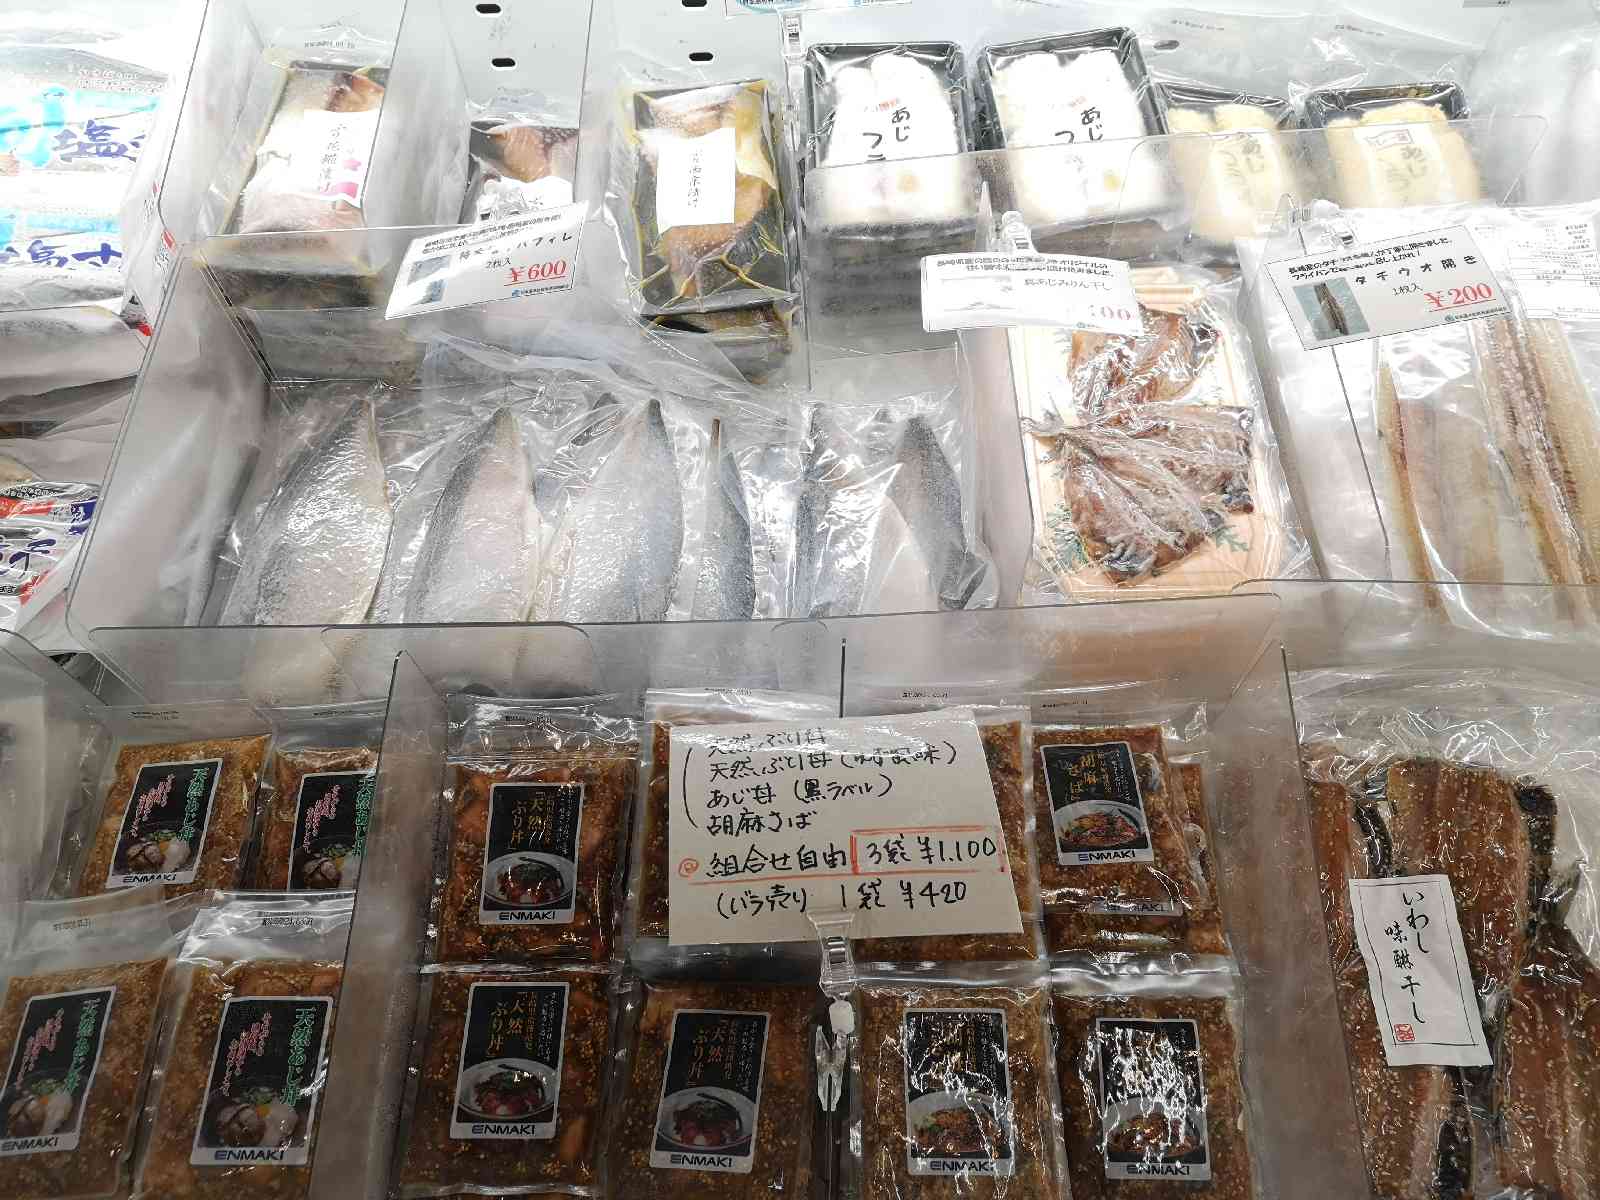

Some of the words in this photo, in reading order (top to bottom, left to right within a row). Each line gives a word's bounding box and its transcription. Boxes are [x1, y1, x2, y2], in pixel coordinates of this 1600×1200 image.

[509, 260, 567, 282] ¥600
[1355, 254, 1478, 285] タチウオ開き
[1423, 282, 1493, 308] ¥200
[707, 783, 776, 808] あじ丼
[706, 807, 817, 837] 胡麻さば
[706, 843, 847, 878] 組合せ自由
[1078, 850, 1136, 862] ENMAKI
[123, 873, 177, 883] ENMAKI
[717, 884, 807, 919] (バラ売り)
[899, 879, 967, 909] ¥420
[499, 911, 555, 921] ENMAKI
[1403, 892, 1430, 954] いわし
[1384, 920, 1426, 1024] 味醂干し
[472, 1124, 536, 1135] ENMAKI
[1, 1136, 58, 1152] ENMAKI
[214, 1150, 285, 1161] ENMAKI
[670, 1154, 732, 1168] ENMAKI
[1126, 1165, 1190, 1175] ENMAKI
